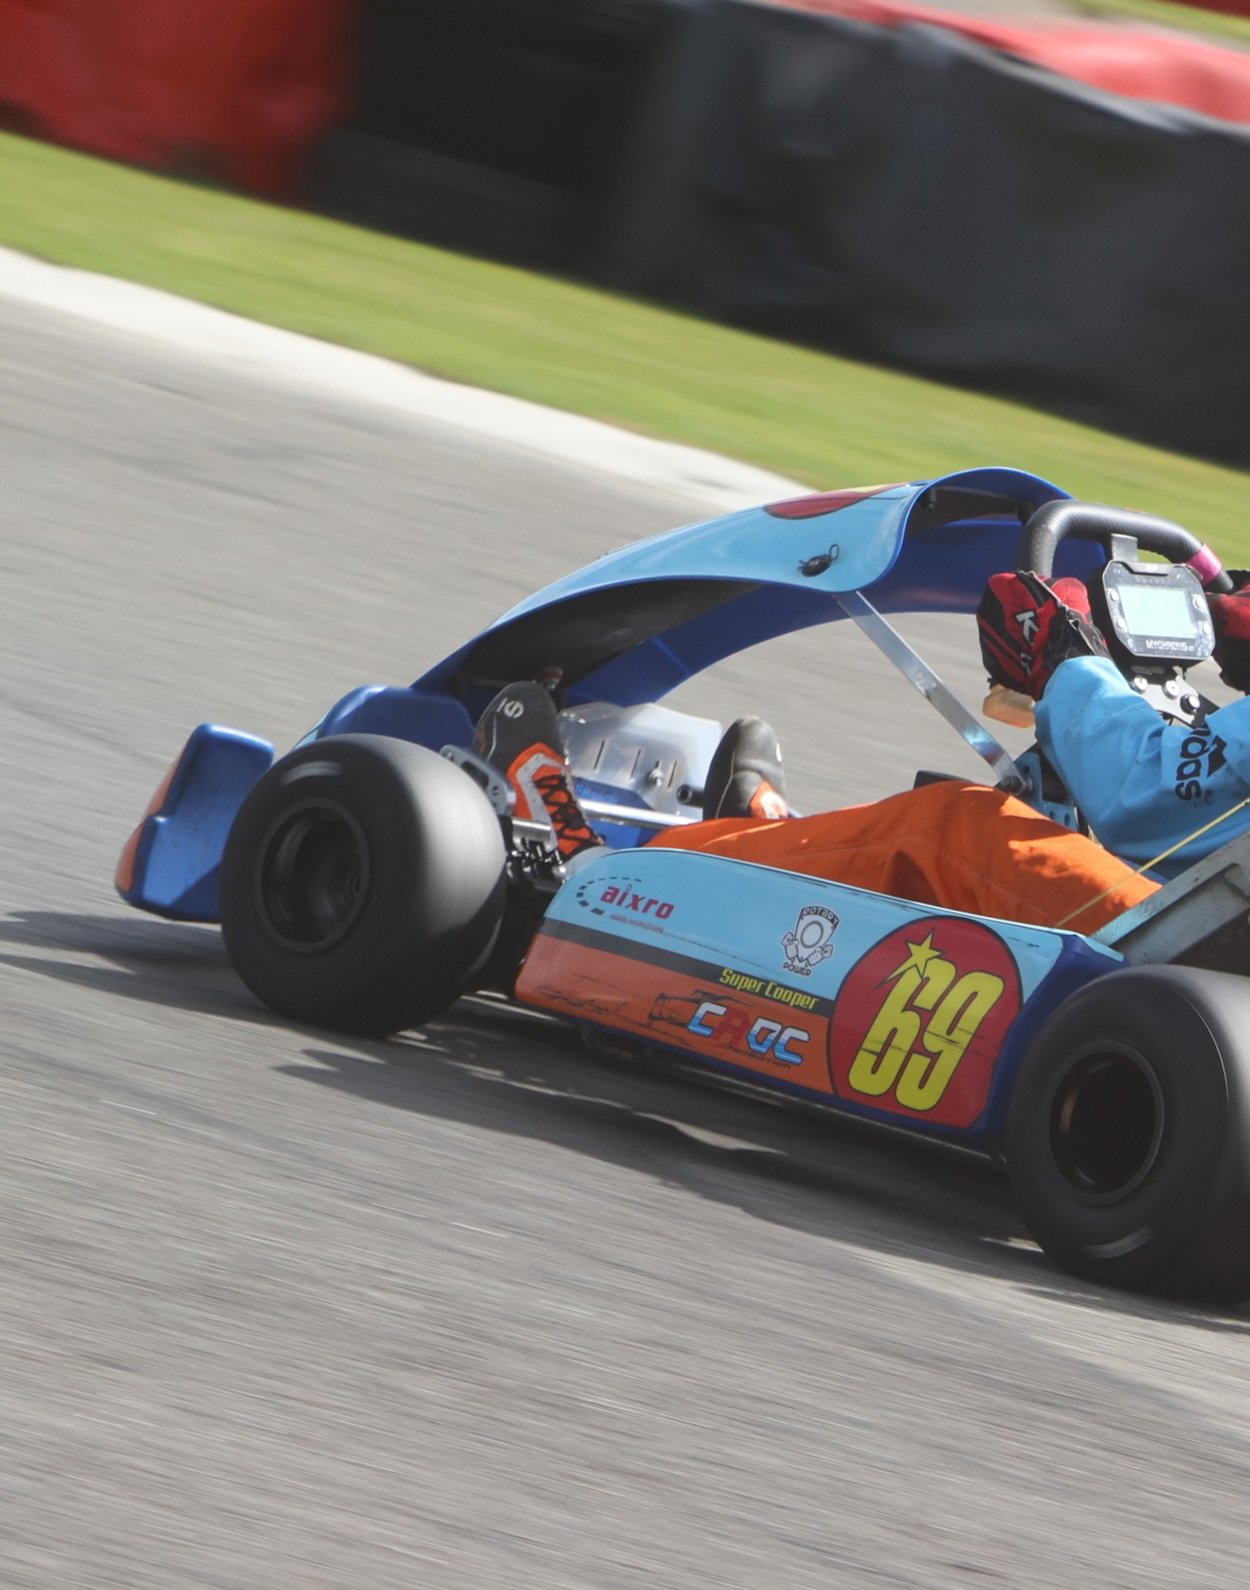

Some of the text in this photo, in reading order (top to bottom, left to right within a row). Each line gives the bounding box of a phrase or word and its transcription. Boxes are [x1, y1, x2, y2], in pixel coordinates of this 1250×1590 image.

[601, 883, 675, 920] aixro
[719, 967, 820, 1010] Super Cooper
[783, 961, 812, 977] POWER
[848, 958, 1005, 1112] 69
